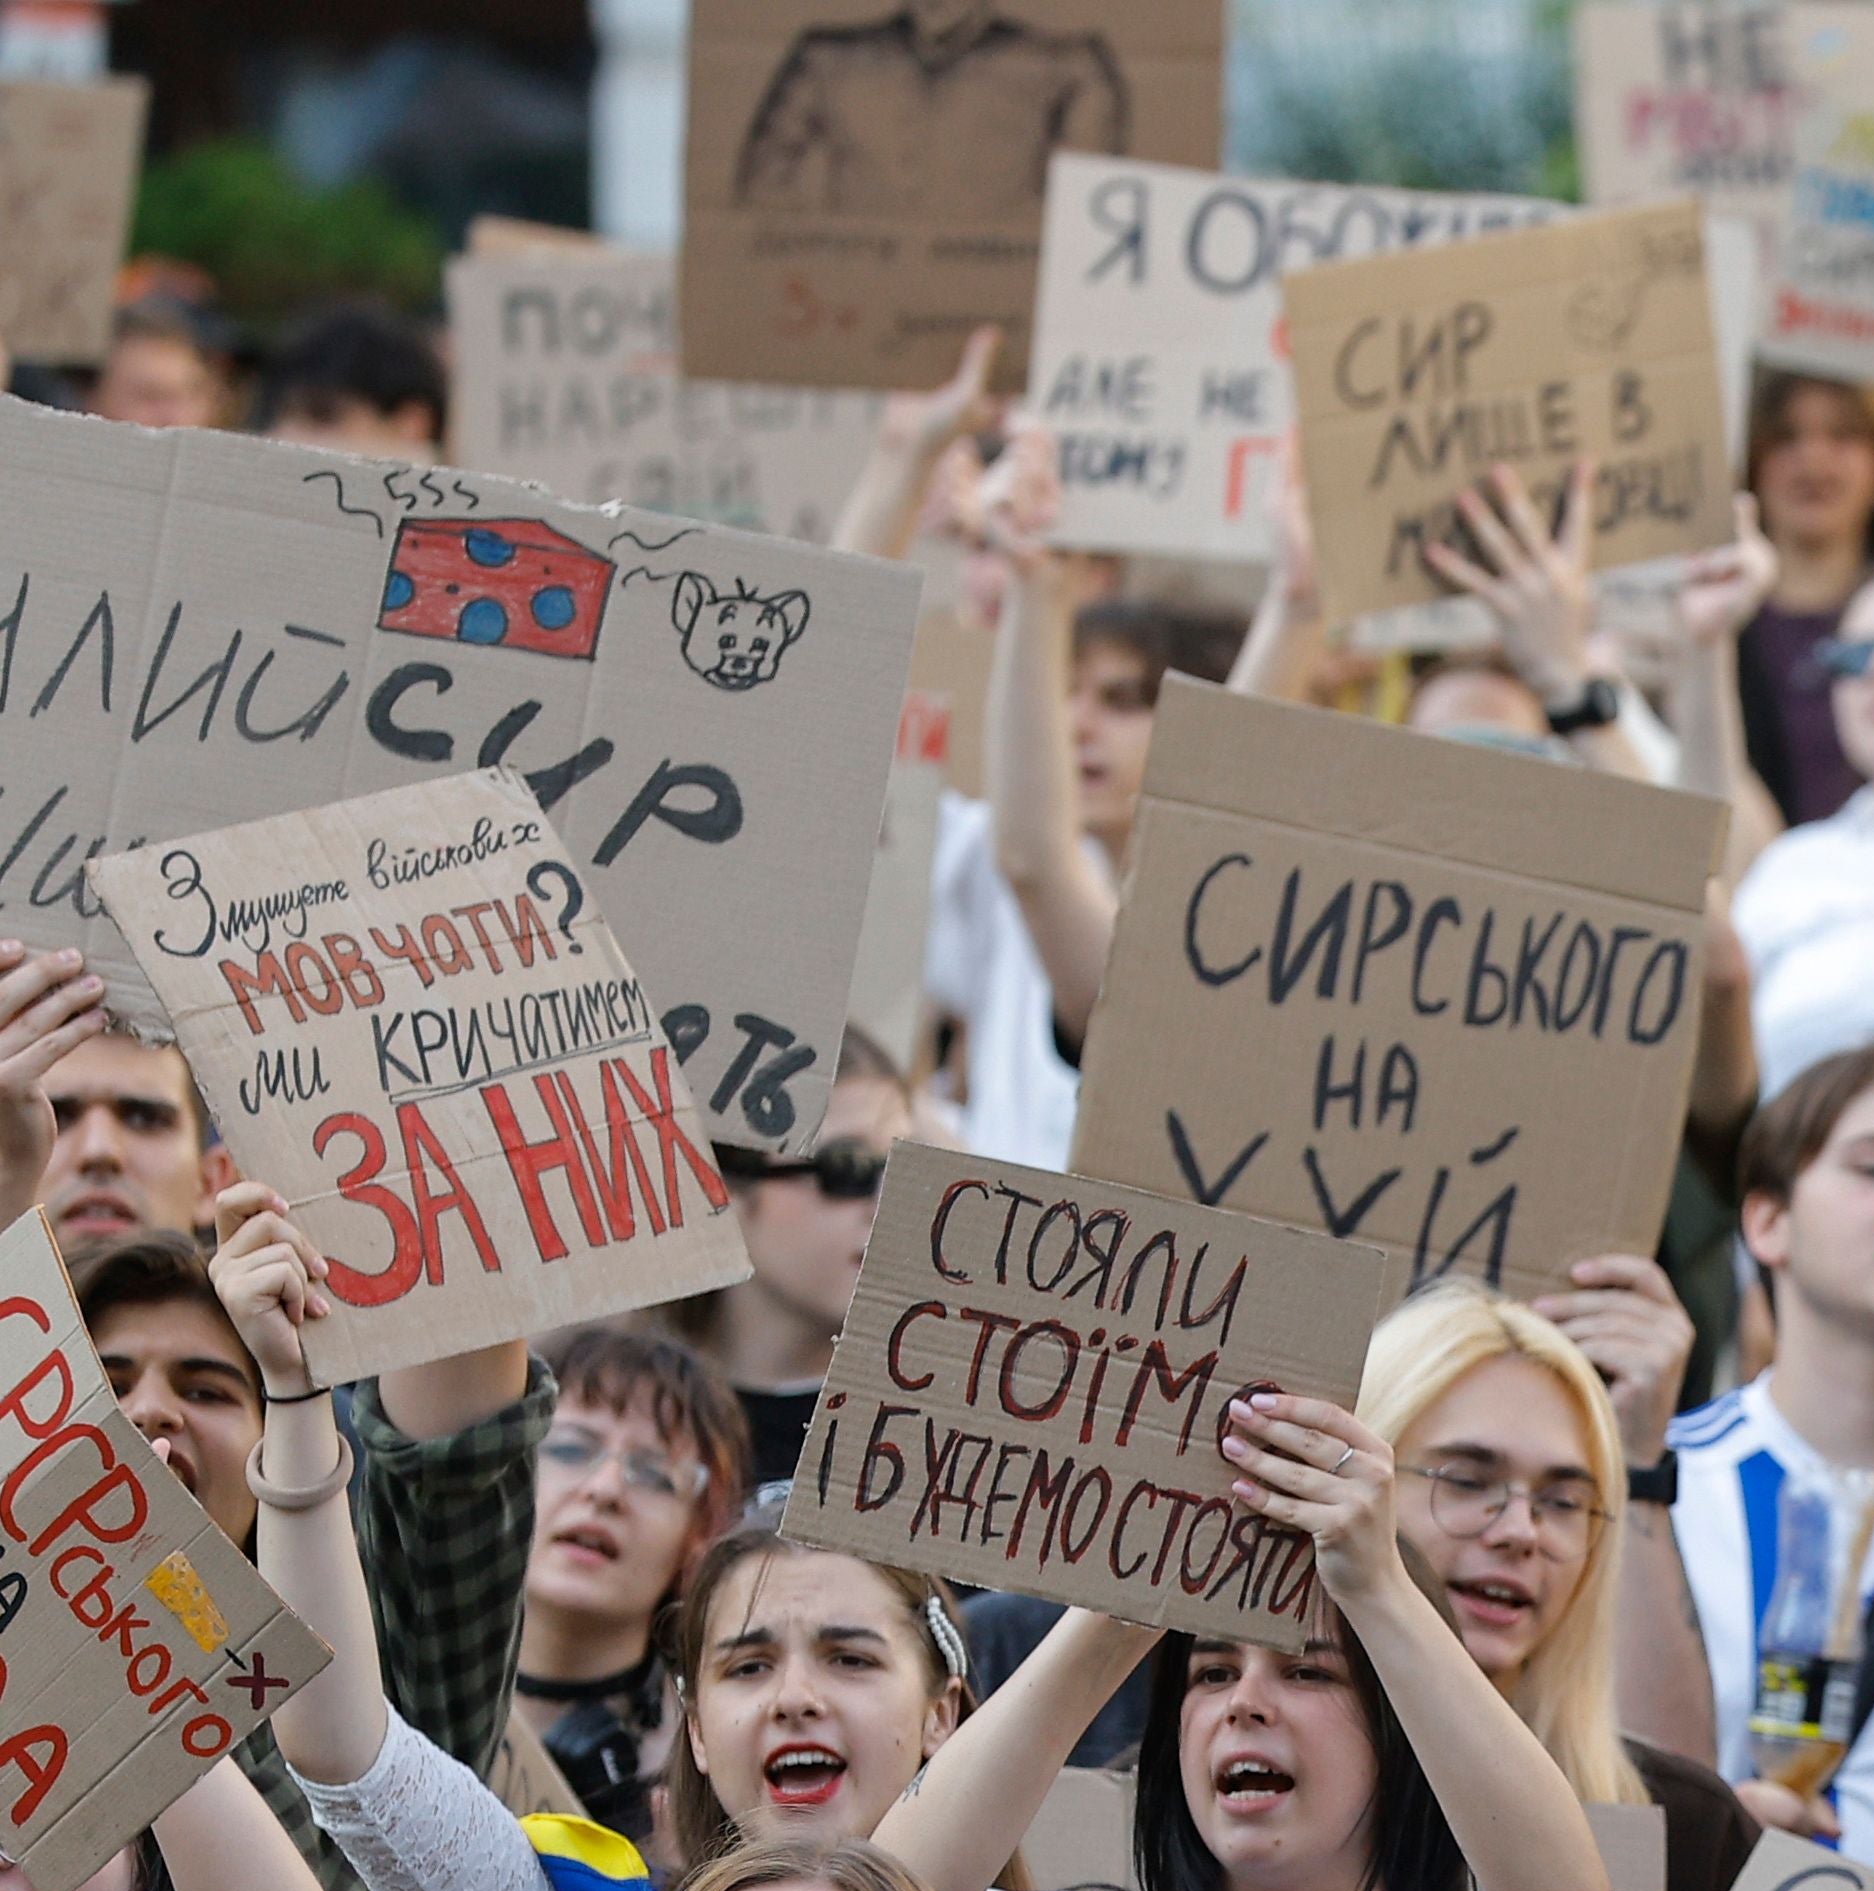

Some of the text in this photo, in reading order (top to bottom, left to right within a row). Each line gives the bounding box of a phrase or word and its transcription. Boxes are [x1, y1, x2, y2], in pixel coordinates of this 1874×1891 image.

[1184, 852, 1690, 1046] СИРСЬКОГО
[312, 1046, 732, 1308] ЗА НИХ
[1312, 1032, 1422, 1134] НА
